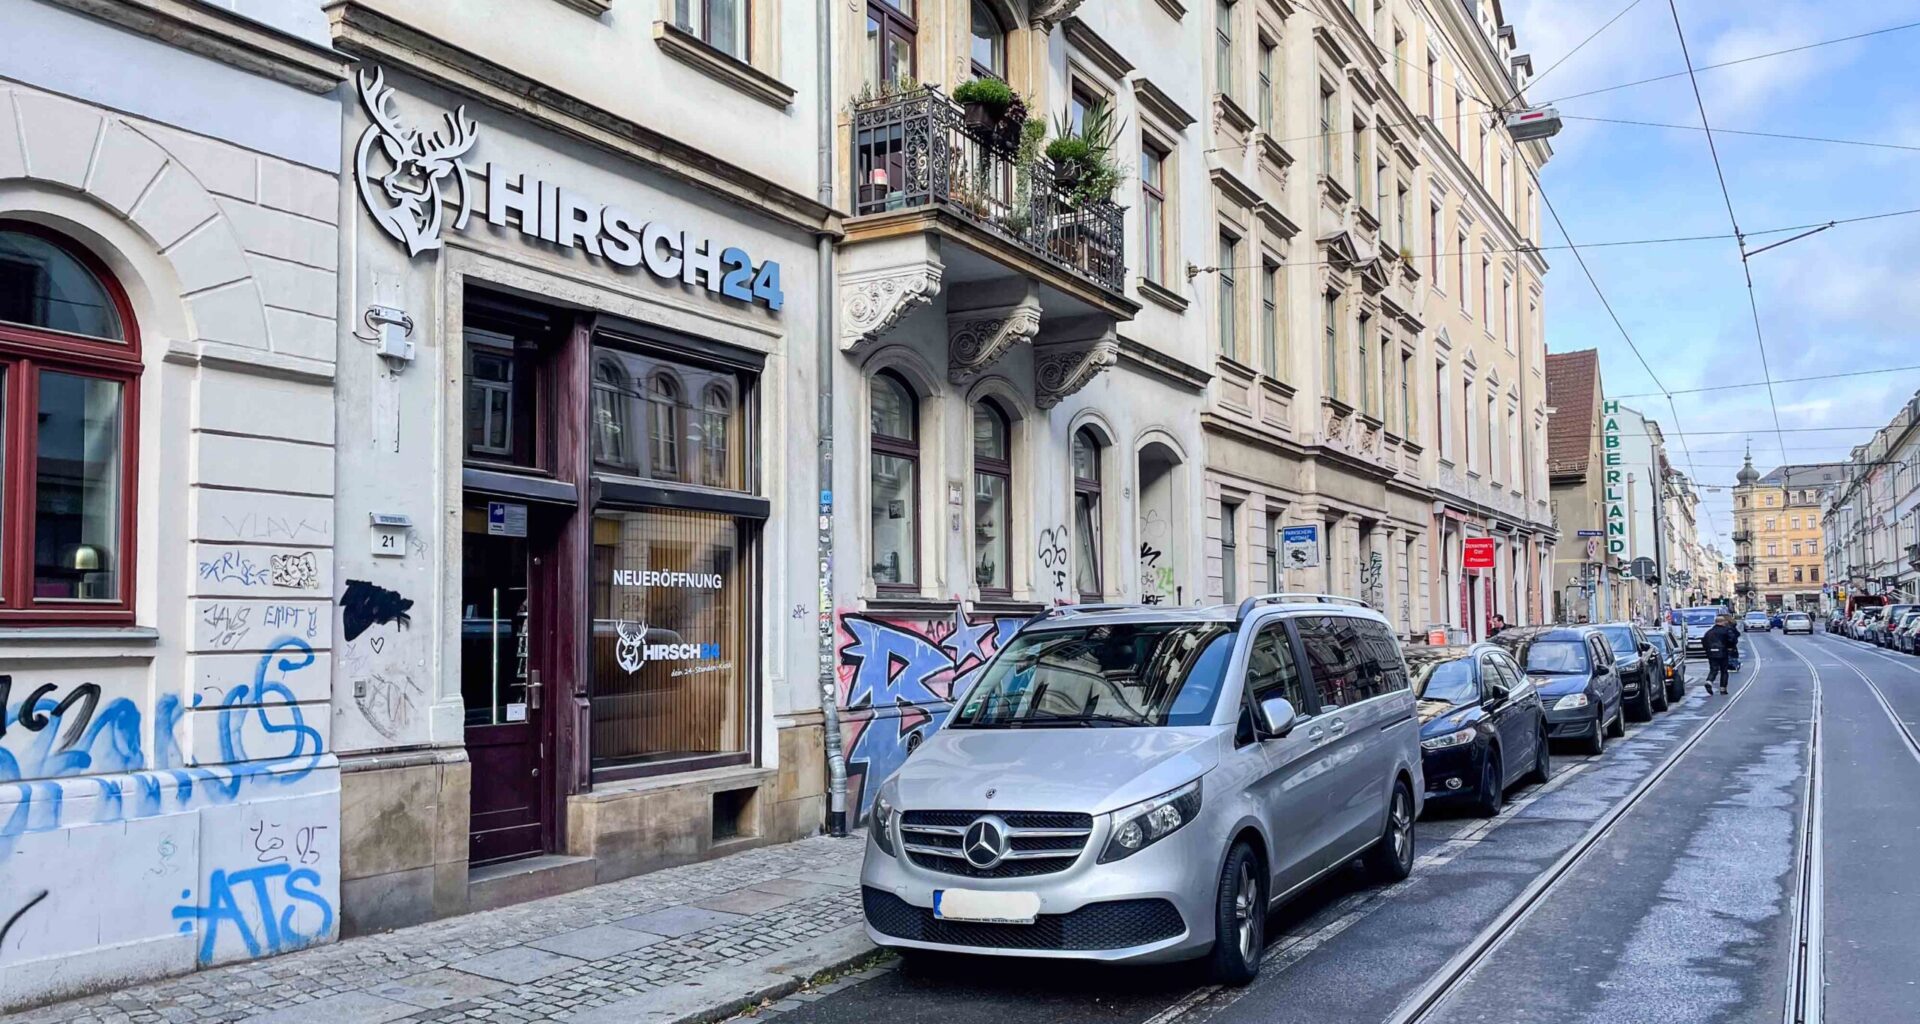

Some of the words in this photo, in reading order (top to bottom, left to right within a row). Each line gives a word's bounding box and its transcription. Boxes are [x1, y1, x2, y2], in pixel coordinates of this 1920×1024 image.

[486, 162, 784, 311] HIRSCH24
[1603, 400, 1626, 553] HABERLAND
[382, 535, 395, 548] 21
[613, 568, 722, 589] NEUERÖFFNUNG
[643, 642, 720, 661] HIRSCH24
